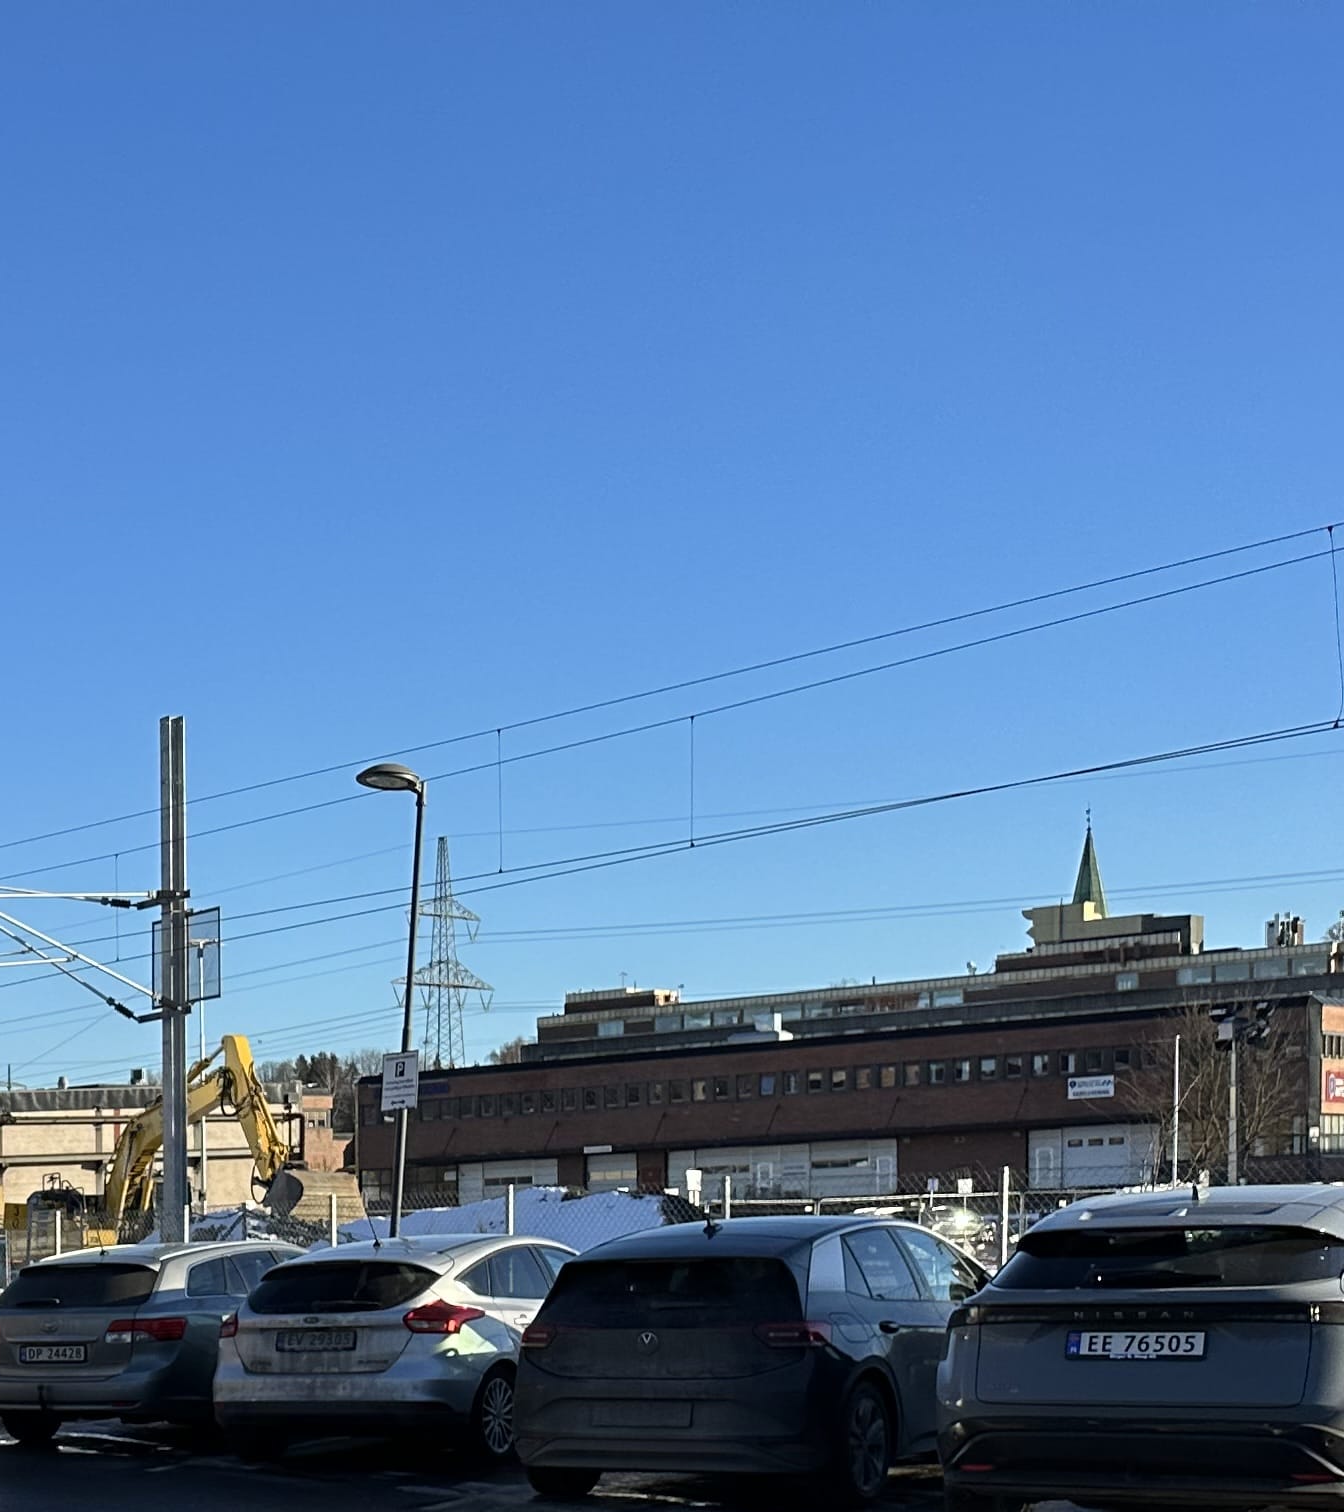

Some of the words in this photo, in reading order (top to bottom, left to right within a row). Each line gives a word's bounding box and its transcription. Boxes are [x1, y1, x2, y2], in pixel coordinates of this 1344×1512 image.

[1073, 1310, 1194, 1320] NISSAN
[1087, 1335, 1112, 1353] EE
[1123, 1335, 1196, 1353] 76505
[28, 1347, 44, 1360] DP
